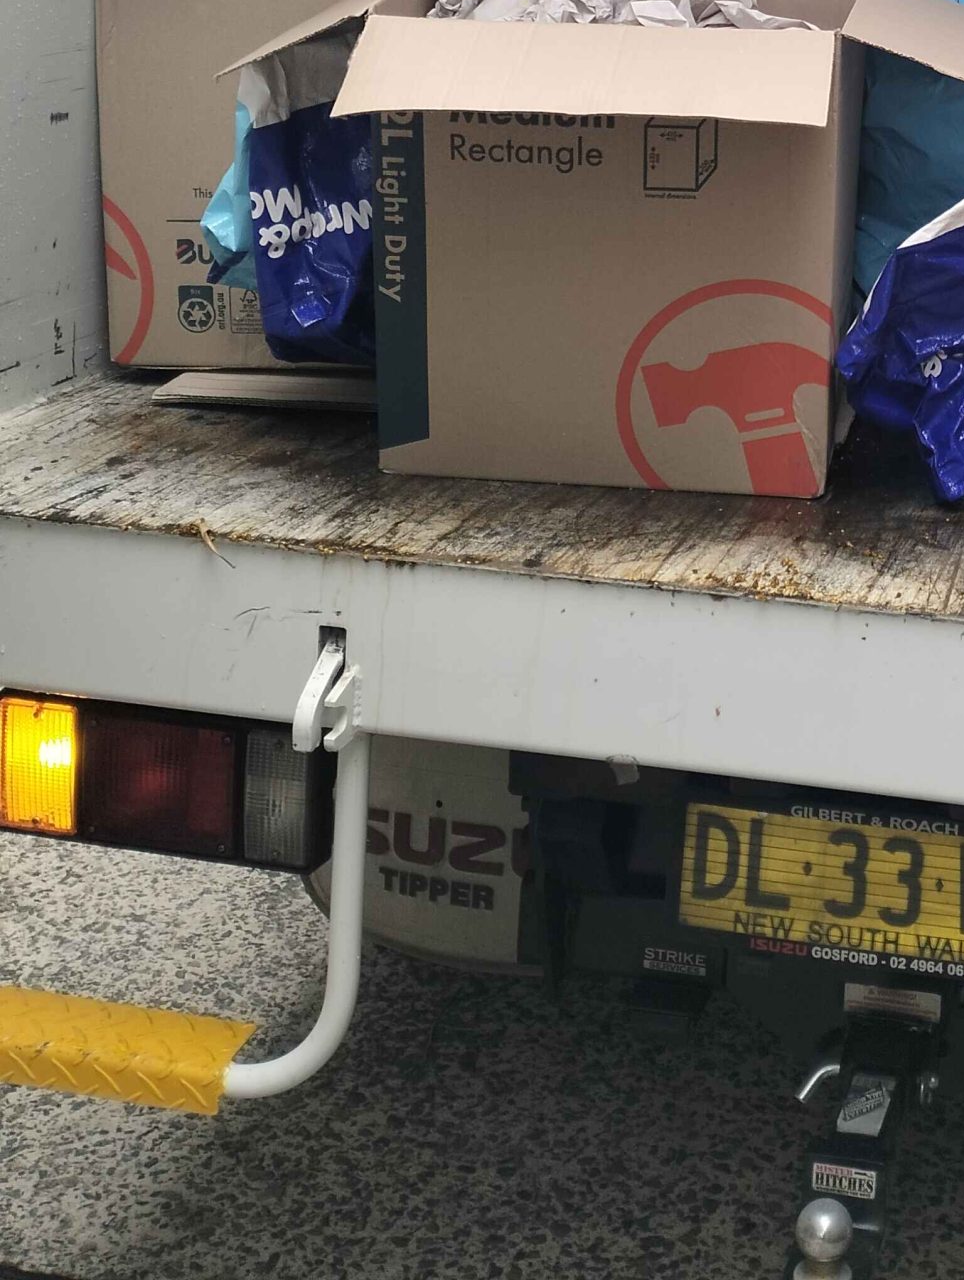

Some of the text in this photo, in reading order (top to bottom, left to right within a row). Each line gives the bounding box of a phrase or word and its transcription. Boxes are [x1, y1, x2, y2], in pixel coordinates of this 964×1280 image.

[450, 133, 604, 173] Rectangle
[375, 156, 409, 224] Light
[258, 223, 291, 259] &
[378, 235, 407, 303] Duty
[790, 804, 960, 836] GILBERT & ROACH
[378, 865, 495, 911] TIPPER
[732, 909, 796, 940] NEW
[806, 920, 900, 954] SOUTH
[643, 946, 707, 967] STRIKE
[749, 936, 808, 957] ISUZU
[811, 946, 879, 966] GOSFORD
[889, 955, 906, 970] 02
[909, 958, 944, 975] 4964
[815, 1173, 875, 1194] HITCHES
